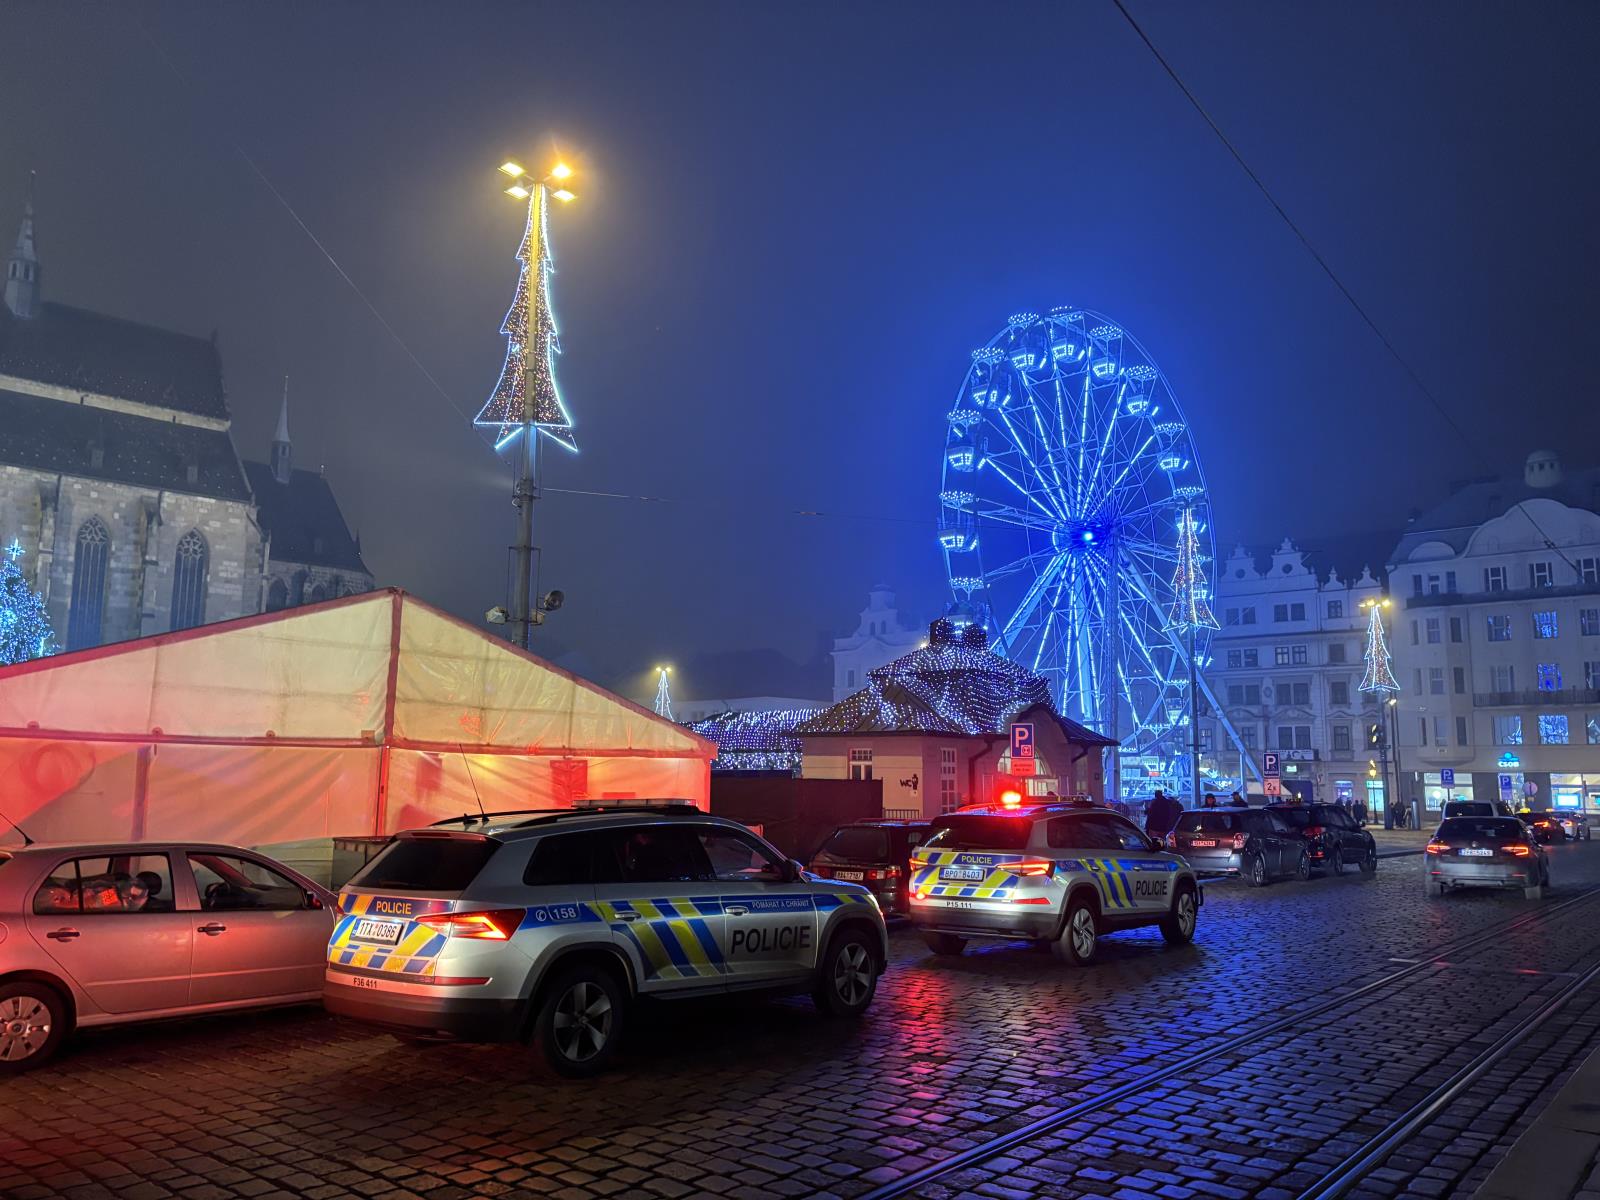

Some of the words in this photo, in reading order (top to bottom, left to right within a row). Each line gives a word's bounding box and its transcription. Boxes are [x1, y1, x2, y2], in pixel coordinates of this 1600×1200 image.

[1015, 727, 1029, 748] P
[1266, 755, 1276, 769] P
[1443, 769, 1451, 780] P
[1502, 777, 1509, 785] P
[900, 779, 912, 788] WC
[961, 855, 992, 865] POLICIE
[962, 870, 980, 880] 8403
[1135, 880, 1168, 896] POLICIE
[376, 901, 412, 914] POLICIE
[553, 907, 577, 920] 158
[359, 921, 373, 936] 1TX
[376, 923, 398, 939] 0386
[731, 926, 810, 954] POLICIE
[365, 979, 377, 989] 411
